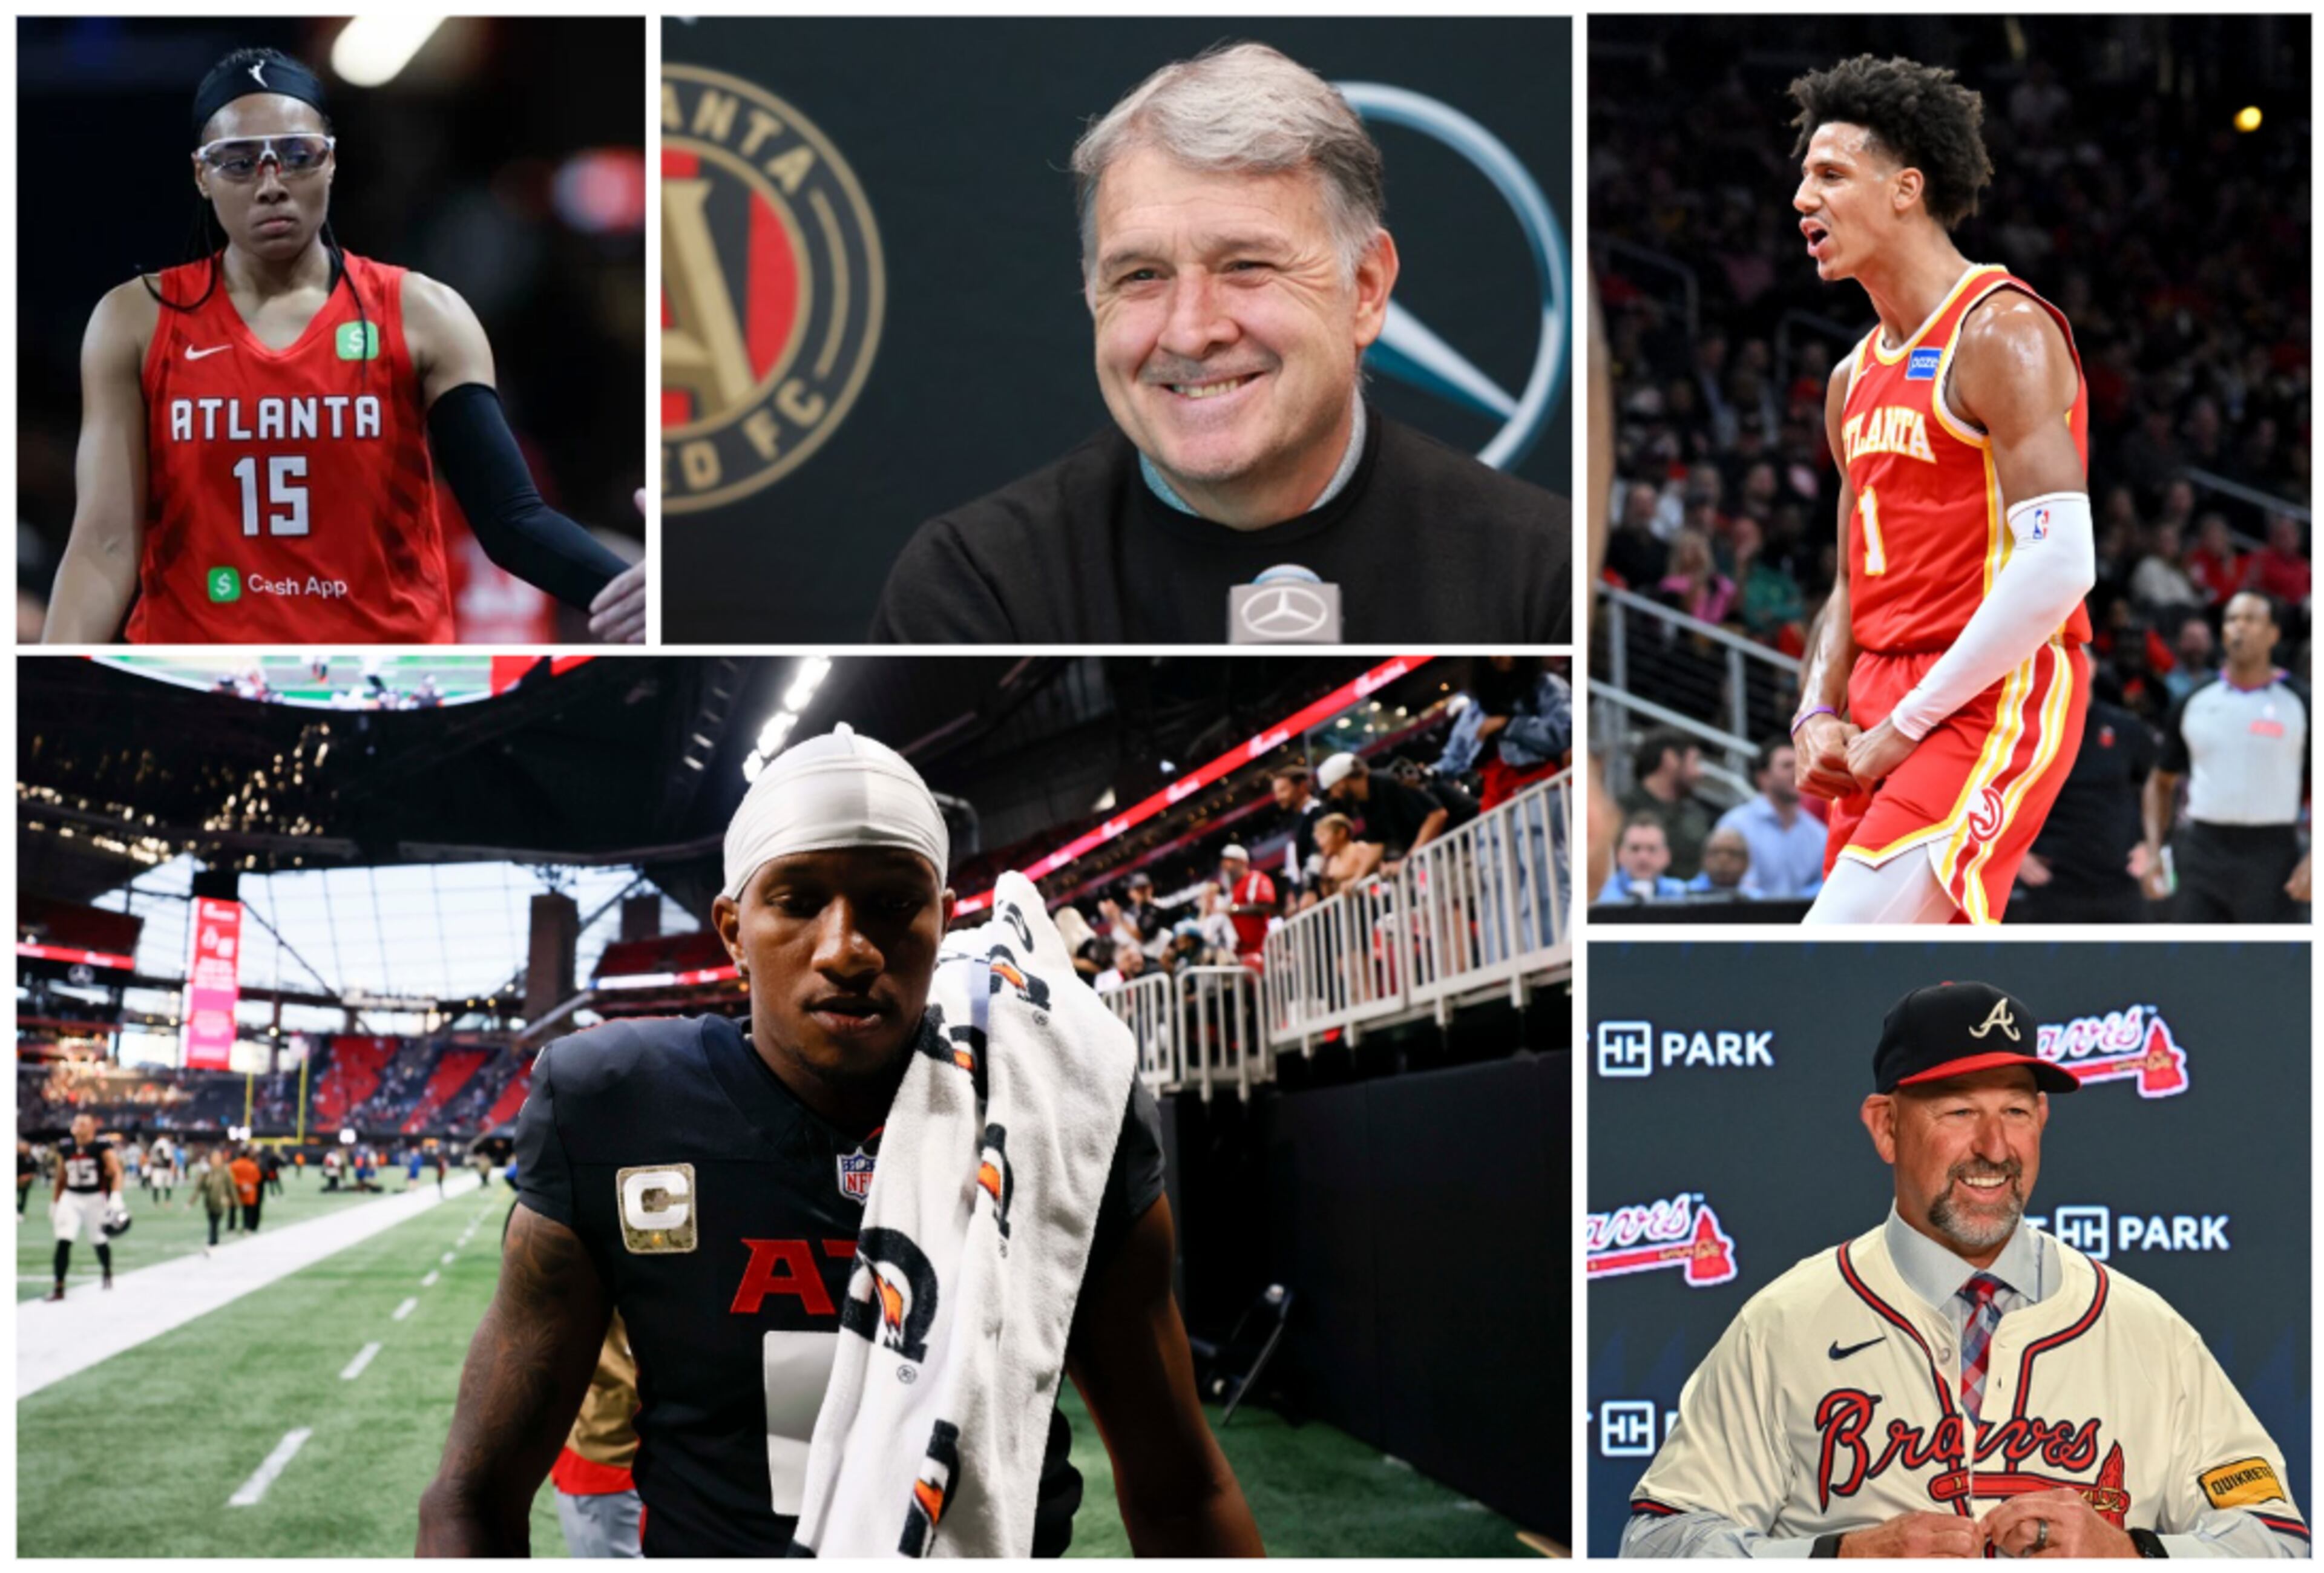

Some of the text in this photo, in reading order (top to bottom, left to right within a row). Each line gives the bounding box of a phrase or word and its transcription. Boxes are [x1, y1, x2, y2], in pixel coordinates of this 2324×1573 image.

[171, 396, 382, 441] ATLANTA
[743, 379, 826, 461] FC
[1842, 406, 1937, 465] TLANTA
[232, 456, 309, 536] 15
[1859, 485, 1886, 576] 1
[248, 574, 299, 595] Cash
[304, 577, 348, 597] App
[1969, 997, 2021, 1041] A
[1661, 1031, 1774, 1066] PARK
[623, 1171, 690, 1230] C
[845, 1172, 873, 1194] NF
[2118, 1215, 2231, 1251] PARK
[1814, 1388, 2102, 1514] Braves
